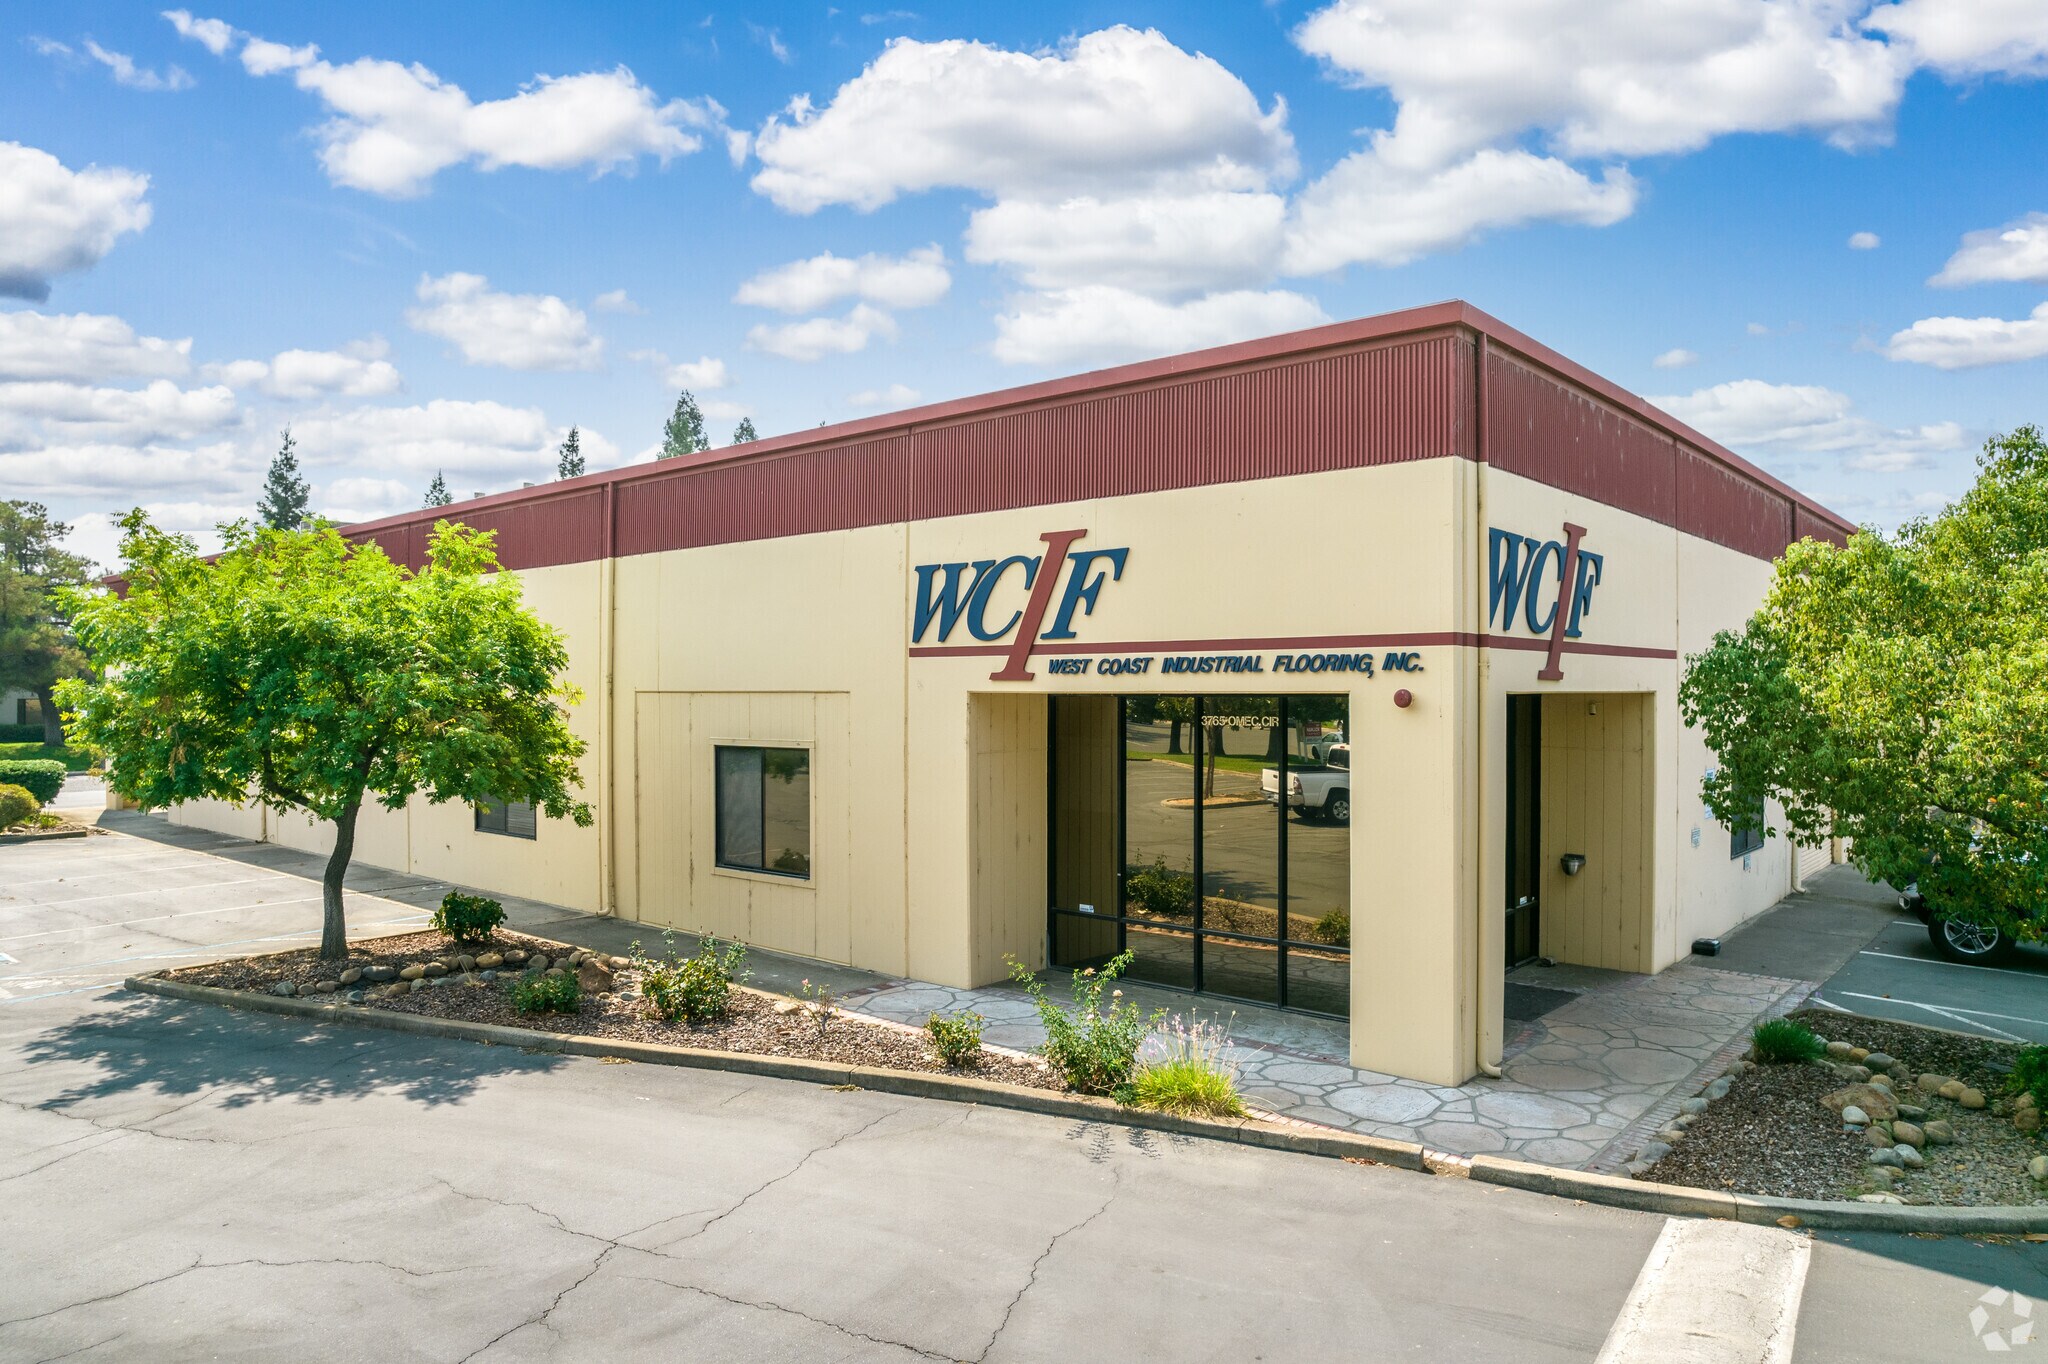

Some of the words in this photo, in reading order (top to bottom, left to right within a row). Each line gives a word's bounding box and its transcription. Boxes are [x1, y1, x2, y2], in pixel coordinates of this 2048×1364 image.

[1048, 658, 1092, 675] WEST
[1096, 656, 1154, 676] COAST
[1161, 655, 1264, 674] INDUSTRIAL
[1272, 652, 1376, 679] FLOORING,
[1382, 652, 1425, 673] INC.
[1201, 715, 1226, 726] 3765
